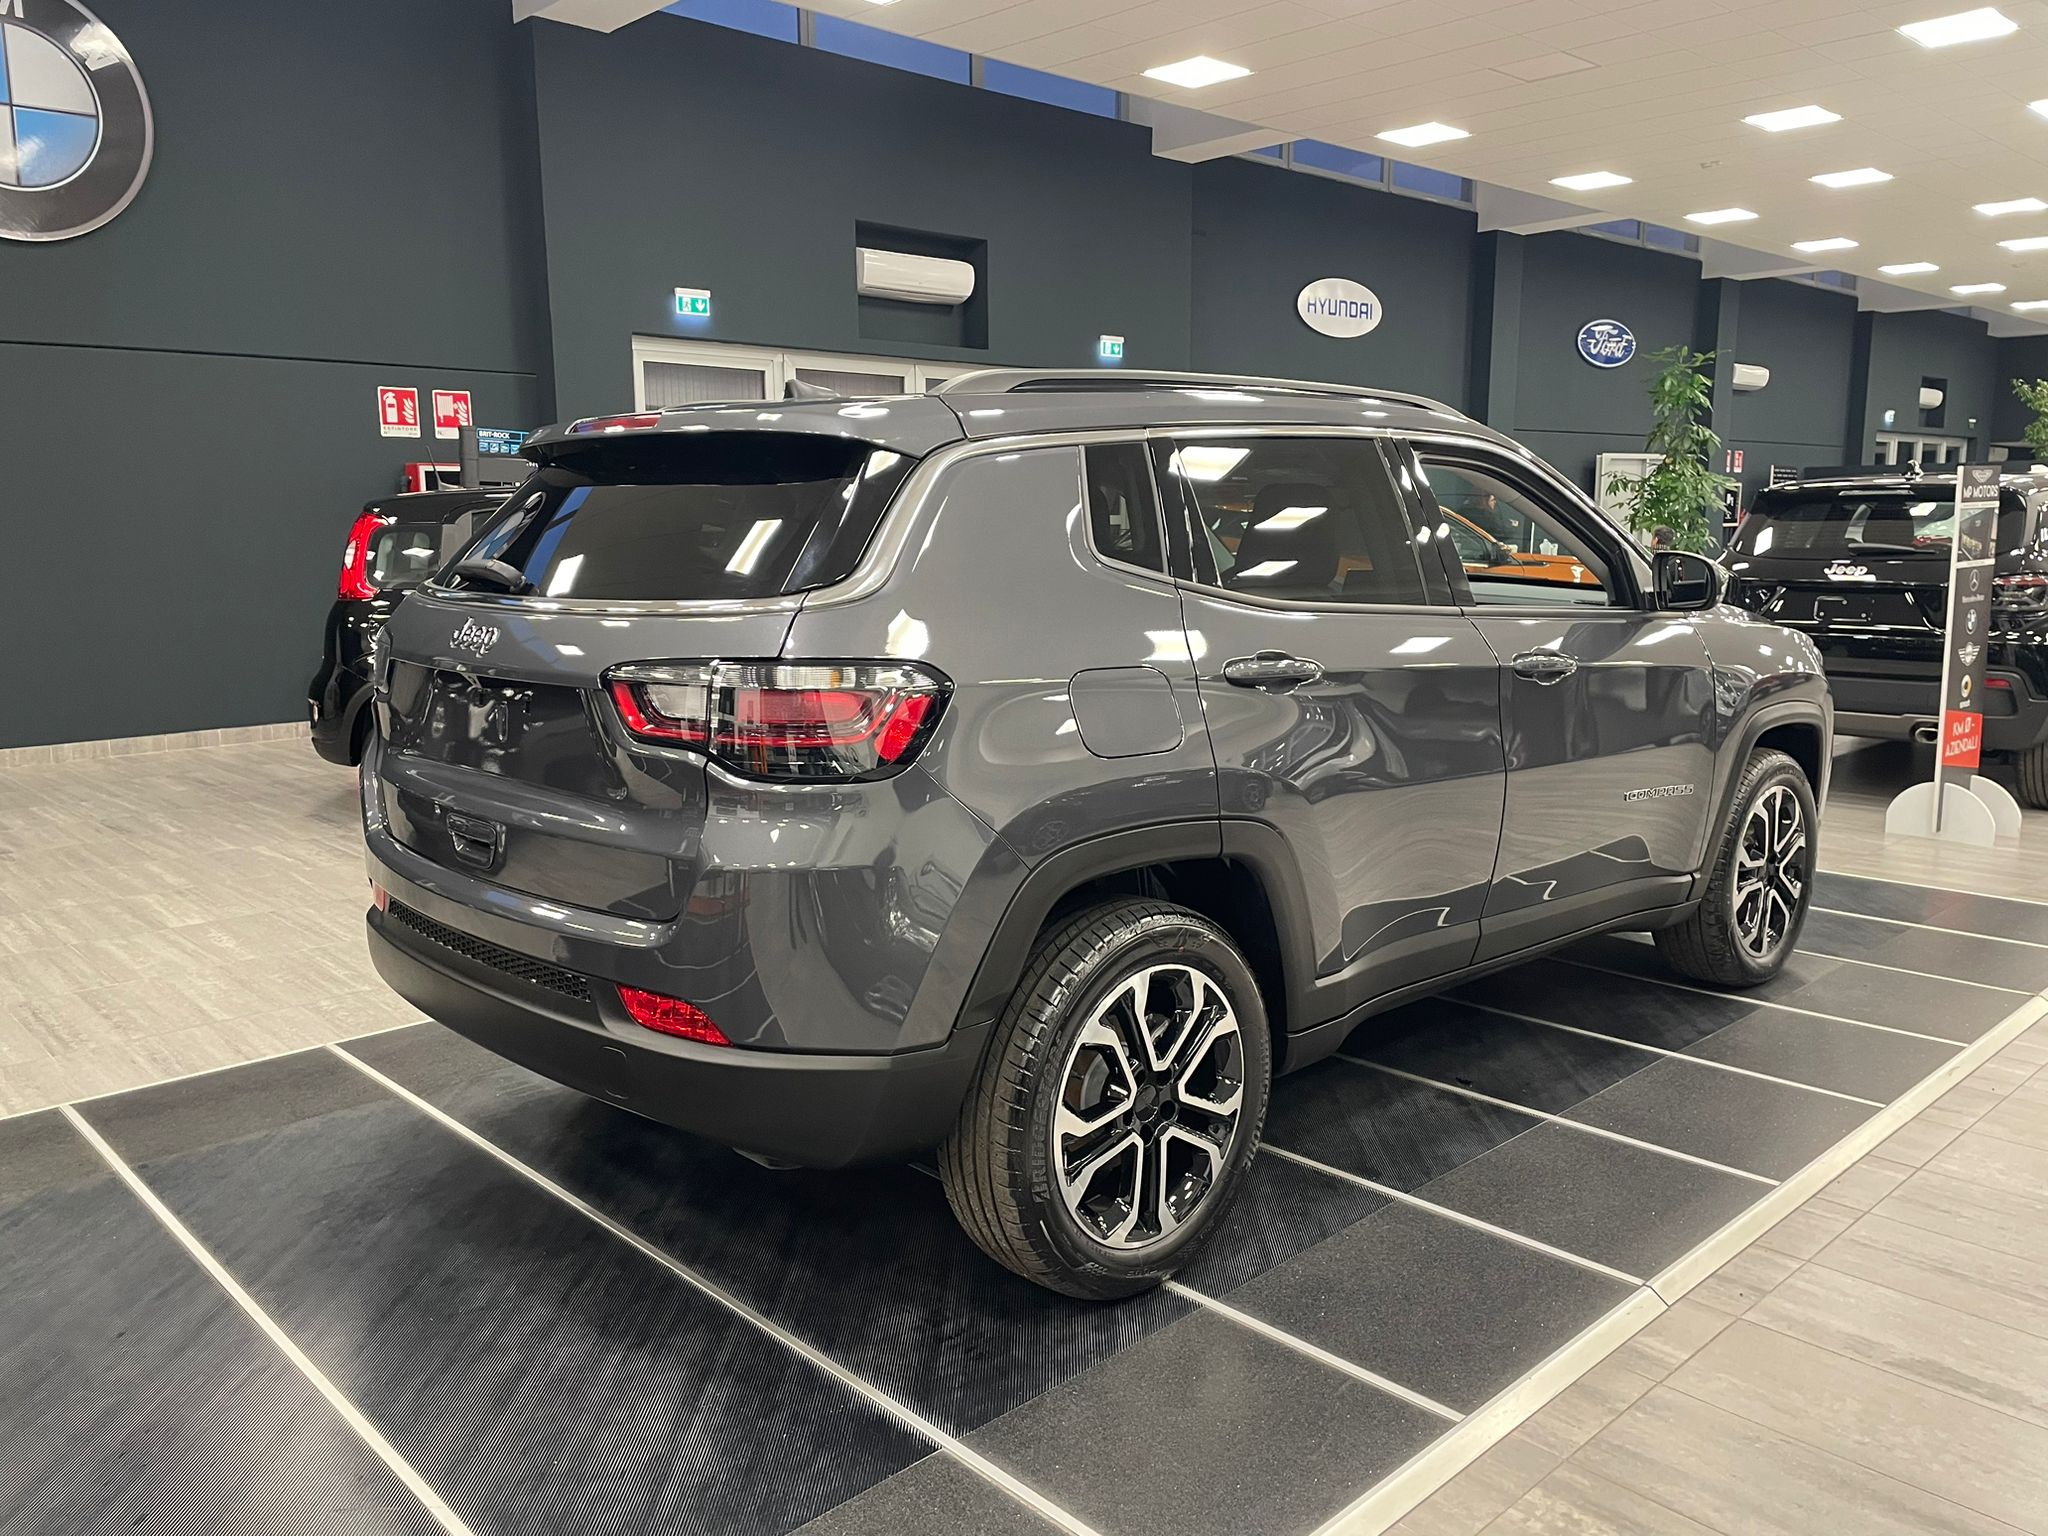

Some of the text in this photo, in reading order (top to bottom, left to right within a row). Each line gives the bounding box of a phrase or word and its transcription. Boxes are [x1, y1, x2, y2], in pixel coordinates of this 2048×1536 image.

[1307, 296, 1373, 320] HYUNDAI
[1586, 325, 1632, 357] Ford
[478, 430, 510, 439] BRIT-ROCK
[1963, 484, 1999, 498] MP MOTORS
[1823, 563, 1868, 577] Jeep
[449, 616, 500, 658] Jeep
[1944, 735, 1979, 758] AZIENDALI
[1625, 784, 1694, 802] COMPASS
